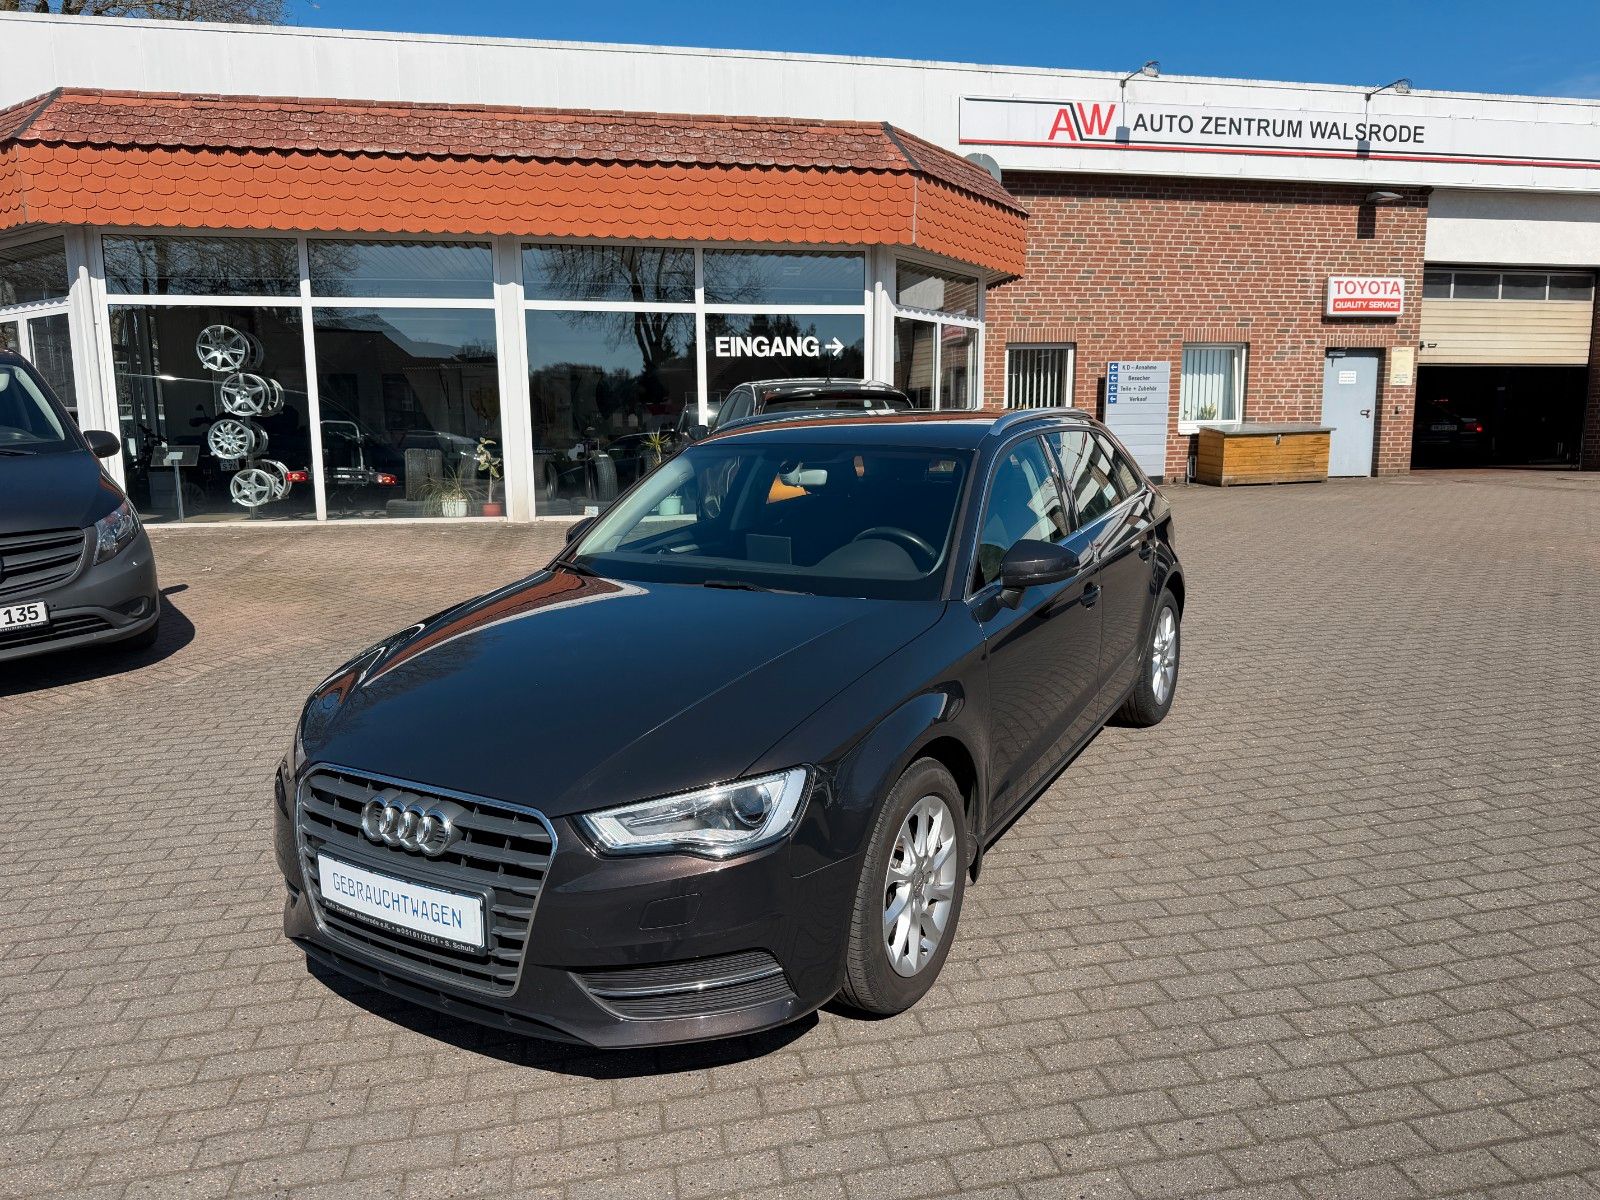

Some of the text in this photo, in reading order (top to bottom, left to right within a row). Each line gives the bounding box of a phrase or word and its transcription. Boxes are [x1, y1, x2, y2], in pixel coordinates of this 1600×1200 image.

[1132, 112, 1426, 145] AUTO ZENTRUM WALSRODE
[1334, 280, 1401, 295] TOYOTA
[1335, 300, 1399, 309] QUALITY SERVICE
[714, 335, 821, 358] EINGANG
[3, 605, 39, 625] 135
[332, 872, 463, 929] GEBRAUCHTWAGEN
